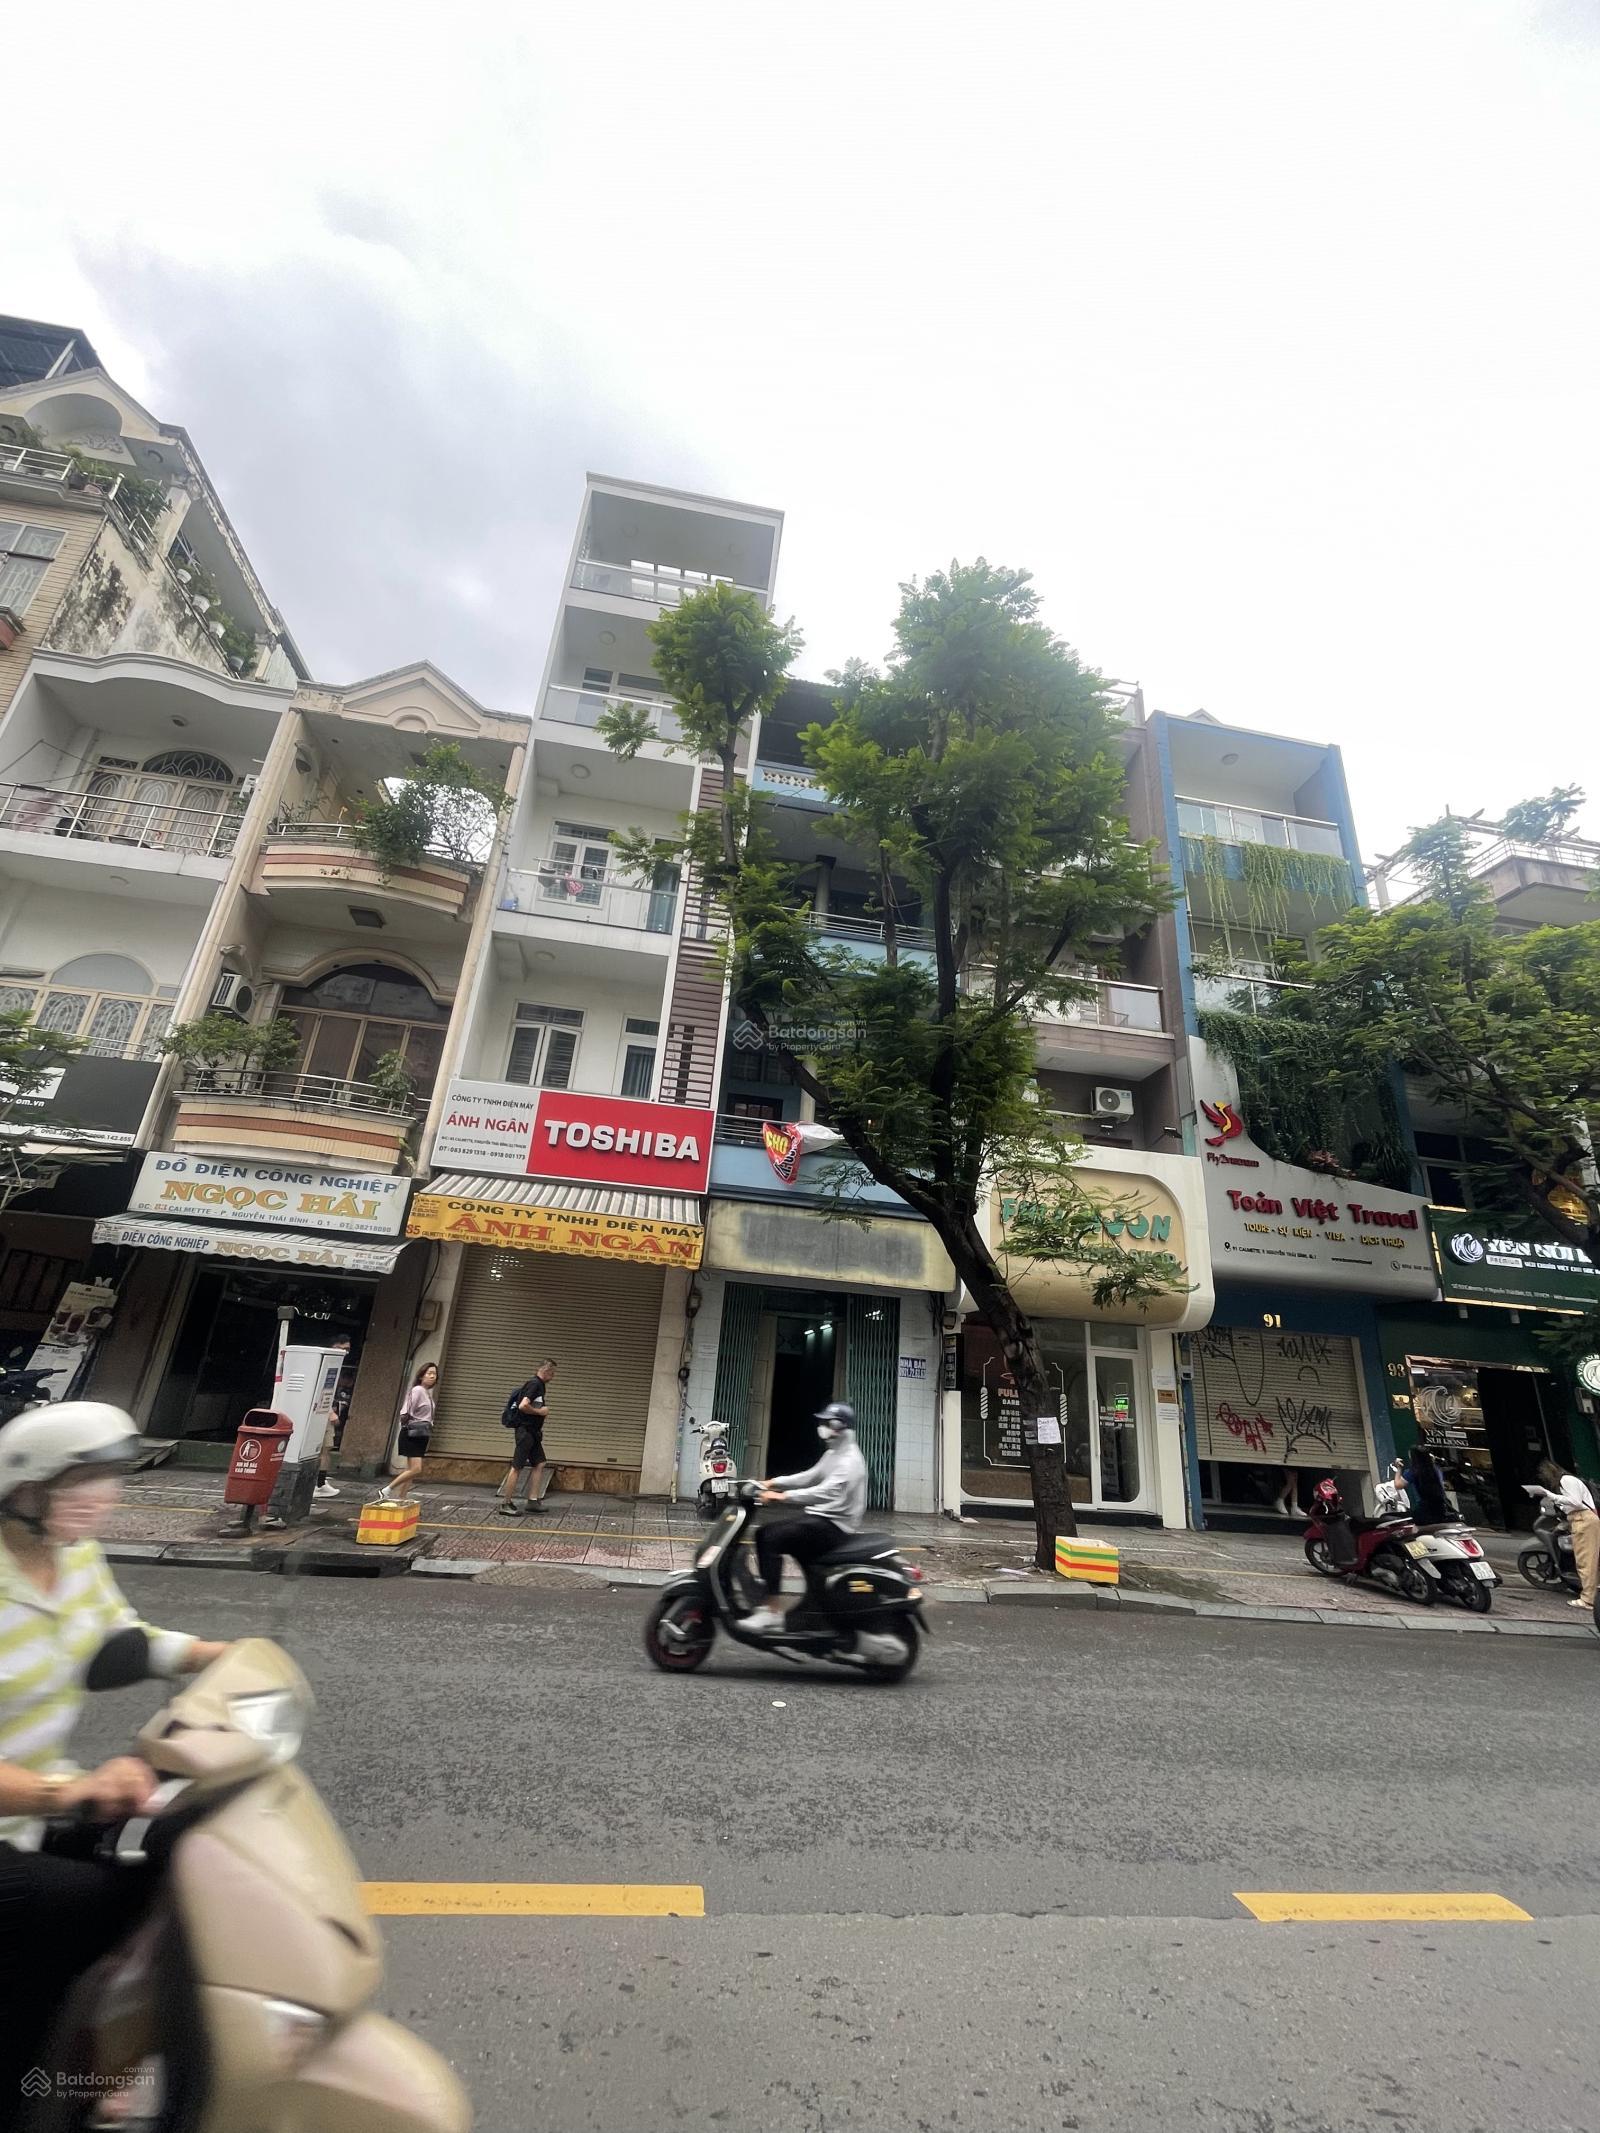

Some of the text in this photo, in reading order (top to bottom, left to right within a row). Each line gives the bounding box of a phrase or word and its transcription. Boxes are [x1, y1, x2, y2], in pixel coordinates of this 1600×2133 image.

[451, 1093, 534, 1110] CÔNG TY TNHH ĐIỆN MÁY
[446, 1110, 529, 1134] ÁNH NGÂN
[544, 1119, 700, 1161] TOSHIBA
[155, 1157, 398, 1194] ĐỒ ĐIỆN CÔNG NGHIỆP
[160, 1180, 289, 1211] NGỌC
[296, 1191, 381, 1221] HẢI
[1226, 1190, 1419, 1230] Toàn Việt Travel
[168, 1205, 212, 1215] CALMETTE
[231, 1209, 265, 1220] NGUYỄN
[268, 1214, 287, 1222] THÁI
[288, 1215, 309, 1224] BÌNH
[447, 1200, 505, 1215] CÔNG
[511, 1208, 537, 1219] TY
[544, 1212, 599, 1226] TNHH
[606, 1220, 654, 1233] ĐIỆN
[660, 1226, 704, 1239] MÁY
[146, 1232, 173, 1247] CÔNG
[445, 1213, 556, 1244] ÁNH
[566, 1229, 701, 1259] NGÂN
[1325, 1231, 1346, 1242] VISA
[214, 1241, 290, 1260] NGỌC
[1263, 1313, 1281, 1328] 91
[1387, 1363, 1406, 1377] 93
